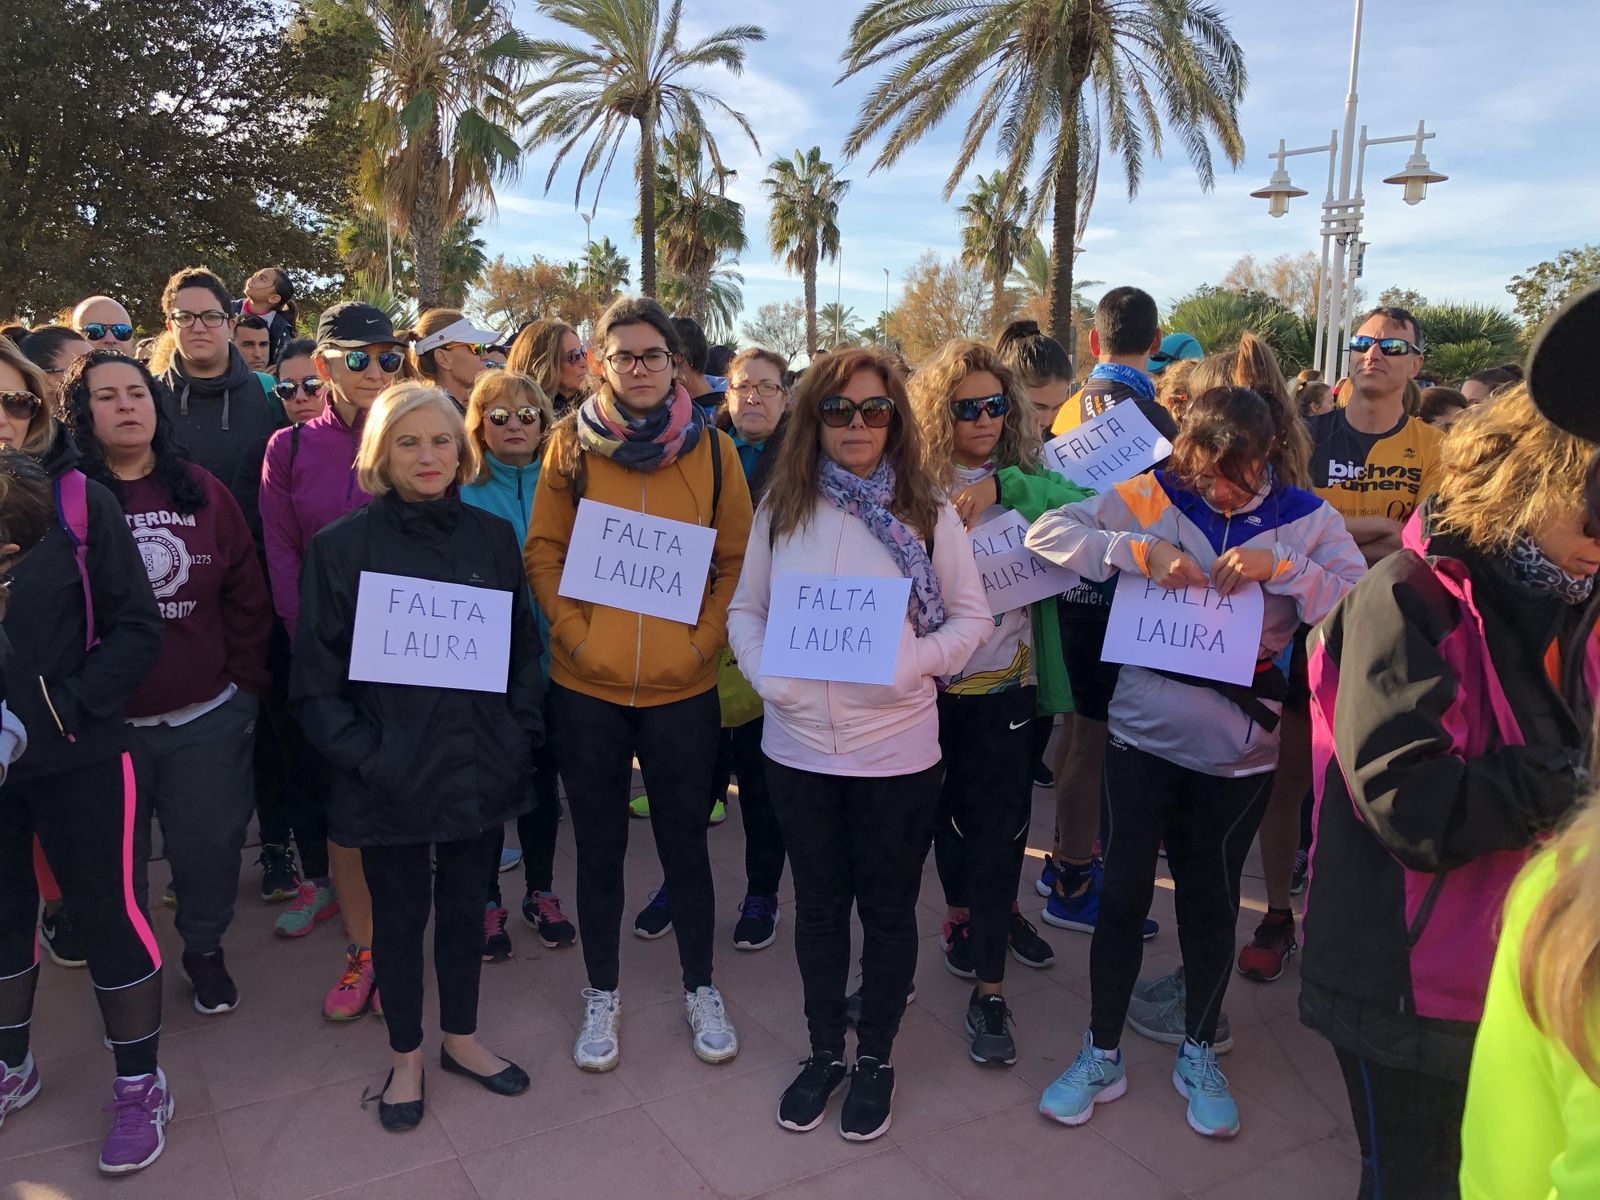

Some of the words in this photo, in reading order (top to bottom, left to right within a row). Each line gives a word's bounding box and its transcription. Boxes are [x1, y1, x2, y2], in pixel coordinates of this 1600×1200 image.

[1054, 417, 1126, 468] FALTA
[1086, 436, 1152, 487] AURA
[1328, 459, 1422, 482] bichos
[1328, 478, 1420, 495] runners
[602, 518, 682, 556] FALTA
[972, 524, 1028, 559] ALTA
[192, 554, 212, 564] 1275
[594, 556, 683, 597] LAURA
[981, 556, 1047, 594] AURA
[389, 588, 486, 624] FALTA
[798, 586, 876, 611] FALTA
[383, 630, 478, 661] LAURA
[790, 626, 872, 654] LAURA
[1136, 617, 1225, 654] LAURA
